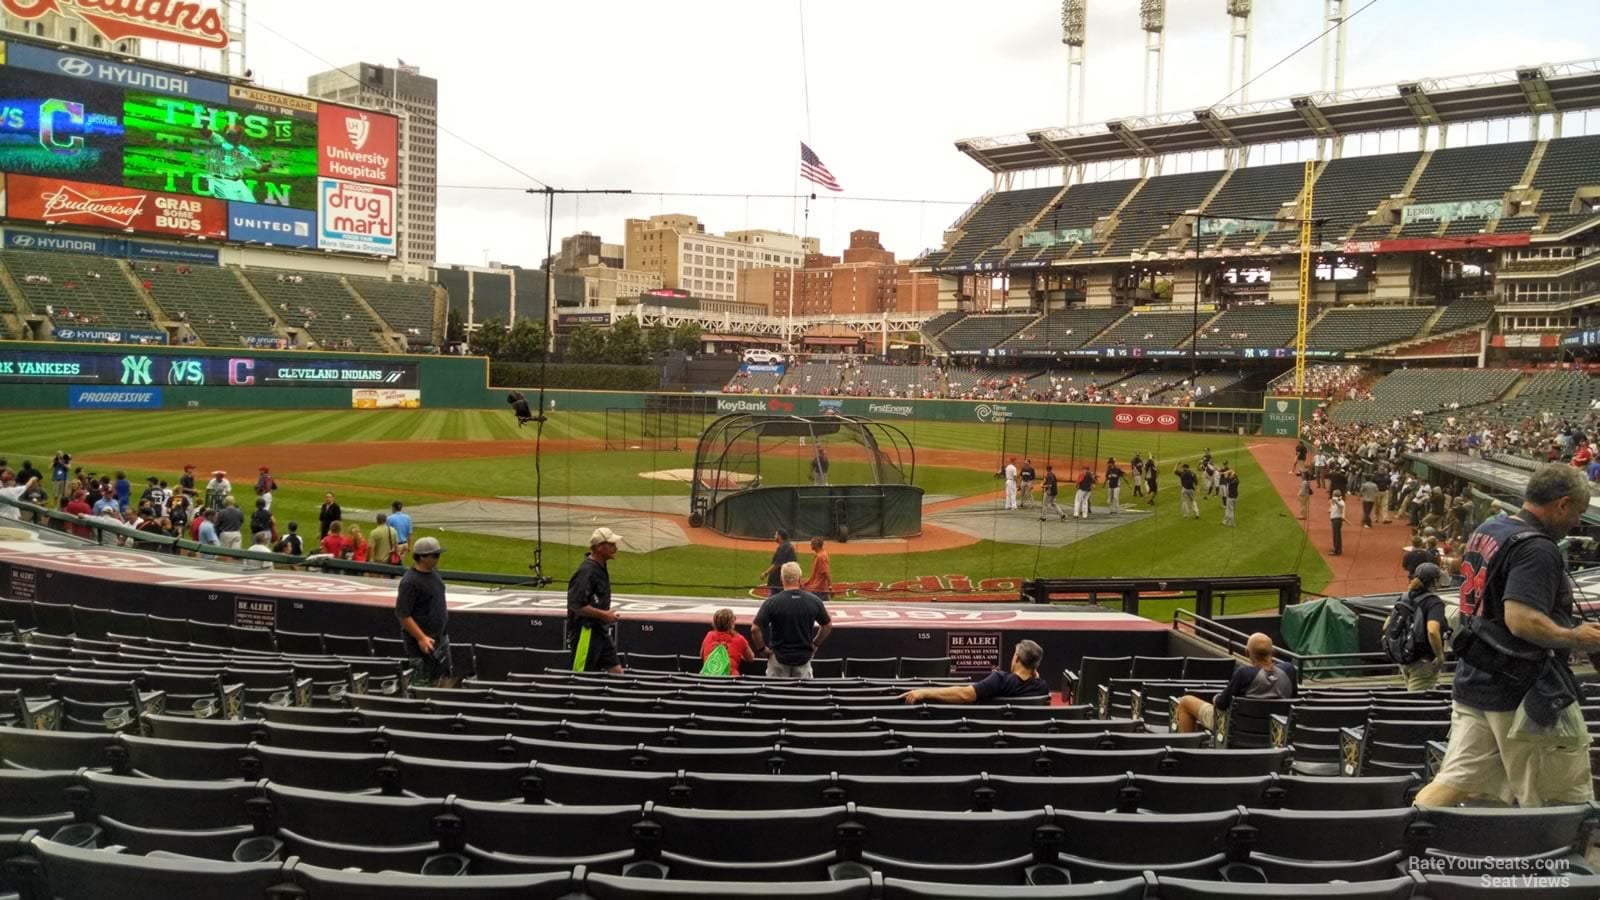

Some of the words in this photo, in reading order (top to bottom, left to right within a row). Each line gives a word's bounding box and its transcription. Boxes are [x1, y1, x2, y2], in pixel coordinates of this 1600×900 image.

[99, 64, 188, 94] HYUNDAI
[290, 98, 313, 111] GAME
[156, 98, 268, 139] THIS
[276, 125, 291, 138] IS
[40, 98, 84, 154] C
[326, 146, 389, 167] University
[329, 161, 387, 181] Hospitals
[41, 192, 143, 216] Budweiser
[155, 197, 202, 213] GRAB
[329, 182, 381, 219] drug
[163, 209, 194, 219] SOME
[1407, 207, 1435, 217] LEMON
[156, 216, 202, 231] BUDS
[234, 217, 292, 233] UNITED
[333, 216, 388, 237] mart
[38, 238, 96, 251] HYUNDAI
[17, 362, 80, 375] YANKEES
[171, 361, 202, 382] VS
[228, 358, 254, 385] C
[278, 368, 339, 379] CLEVELAND
[341, 369, 382, 380] INDIANS
[78, 392, 153, 403] PROGRESSIVE
[717, 400, 767, 412] KeyBank
[869, 403, 913, 417] FirstEnergy
[1270, 414, 1295, 422] TOLEDO
[238, 601, 248, 609] BE
[249, 602, 273, 612] ALERT
[641, 624, 654, 632] 155
[918, 632, 931, 640] 155
[952, 636, 965, 645] BE
[966, 636, 998, 645] ALERT
